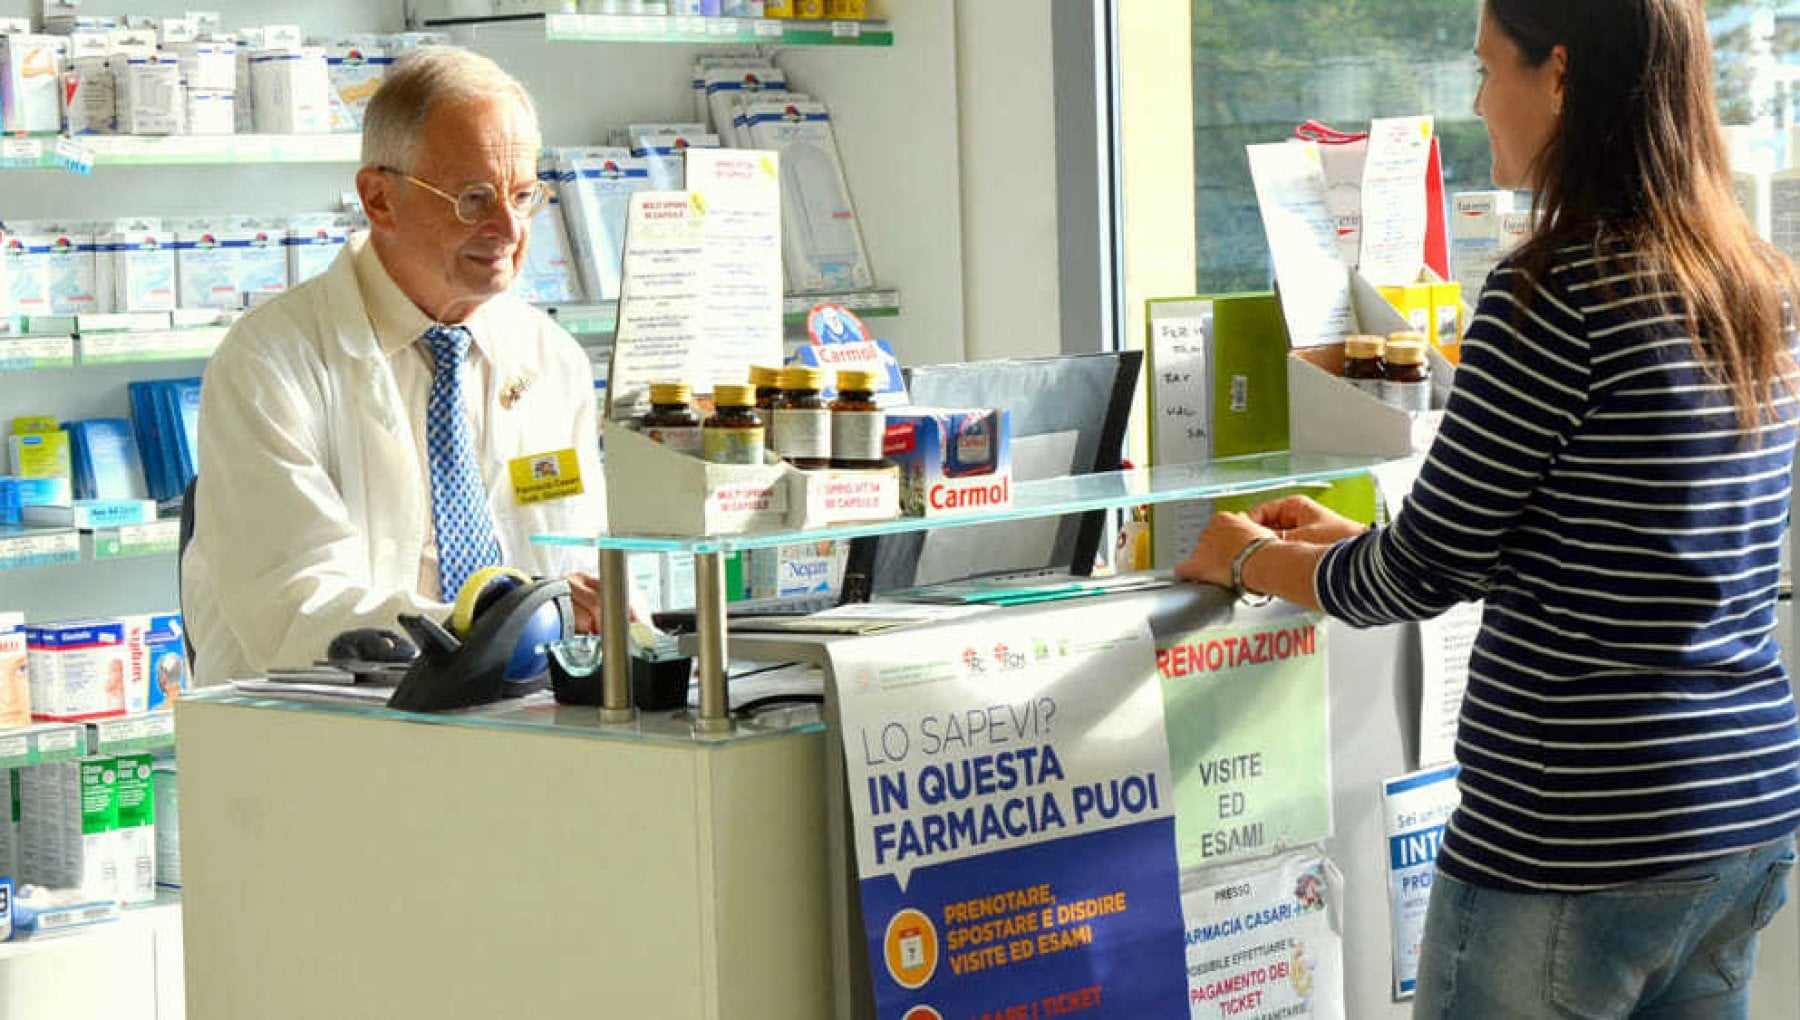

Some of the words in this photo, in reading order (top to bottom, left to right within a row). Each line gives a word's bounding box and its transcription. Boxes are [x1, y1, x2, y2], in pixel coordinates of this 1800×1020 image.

[820, 345, 877, 363] Carmol
[929, 475, 1009, 511] Carmol
[1155, 625, 1315, 679] RENOTAZIONI
[863, 722, 910, 766] LO
[921, 697, 1056, 755] SAPEVI?
[868, 771, 909, 815] IN
[918, 745, 1065, 801] QUESTA
[1199, 753, 1263, 786] VISITE
[873, 793, 1067, 865] FARMACIA
[1072, 773, 1159, 825] PUOI
[1219, 792, 1245, 819] ED
[1201, 823, 1264, 858] ESAMI
[944, 883, 1057, 925] PRENOTARE,
[1214, 883, 1251, 902] PRESSO
[947, 912, 1039, 951] SPOSTARE
[1042, 909, 1054, 928] E
[1057, 892, 1127, 924] DISDIRE
[1186, 917, 1243, 945] ARMACIA
[1245, 903, 1292, 930] CASARI
[950, 947, 1007, 976] VISITE
[1011, 940, 1034, 961] ED
[1038, 925, 1093, 955] ESAMI
[1188, 956, 1231, 976] OSSIBILE
[1232, 939, 1286, 965] EFFETTUARE
[1043, 984, 1103, 1016] TICKET
[1191, 967, 1266, 1005] PAGAMENTO
[1269, 961, 1290, 981] DEI
[1220, 990, 1263, 1017] TICKET
